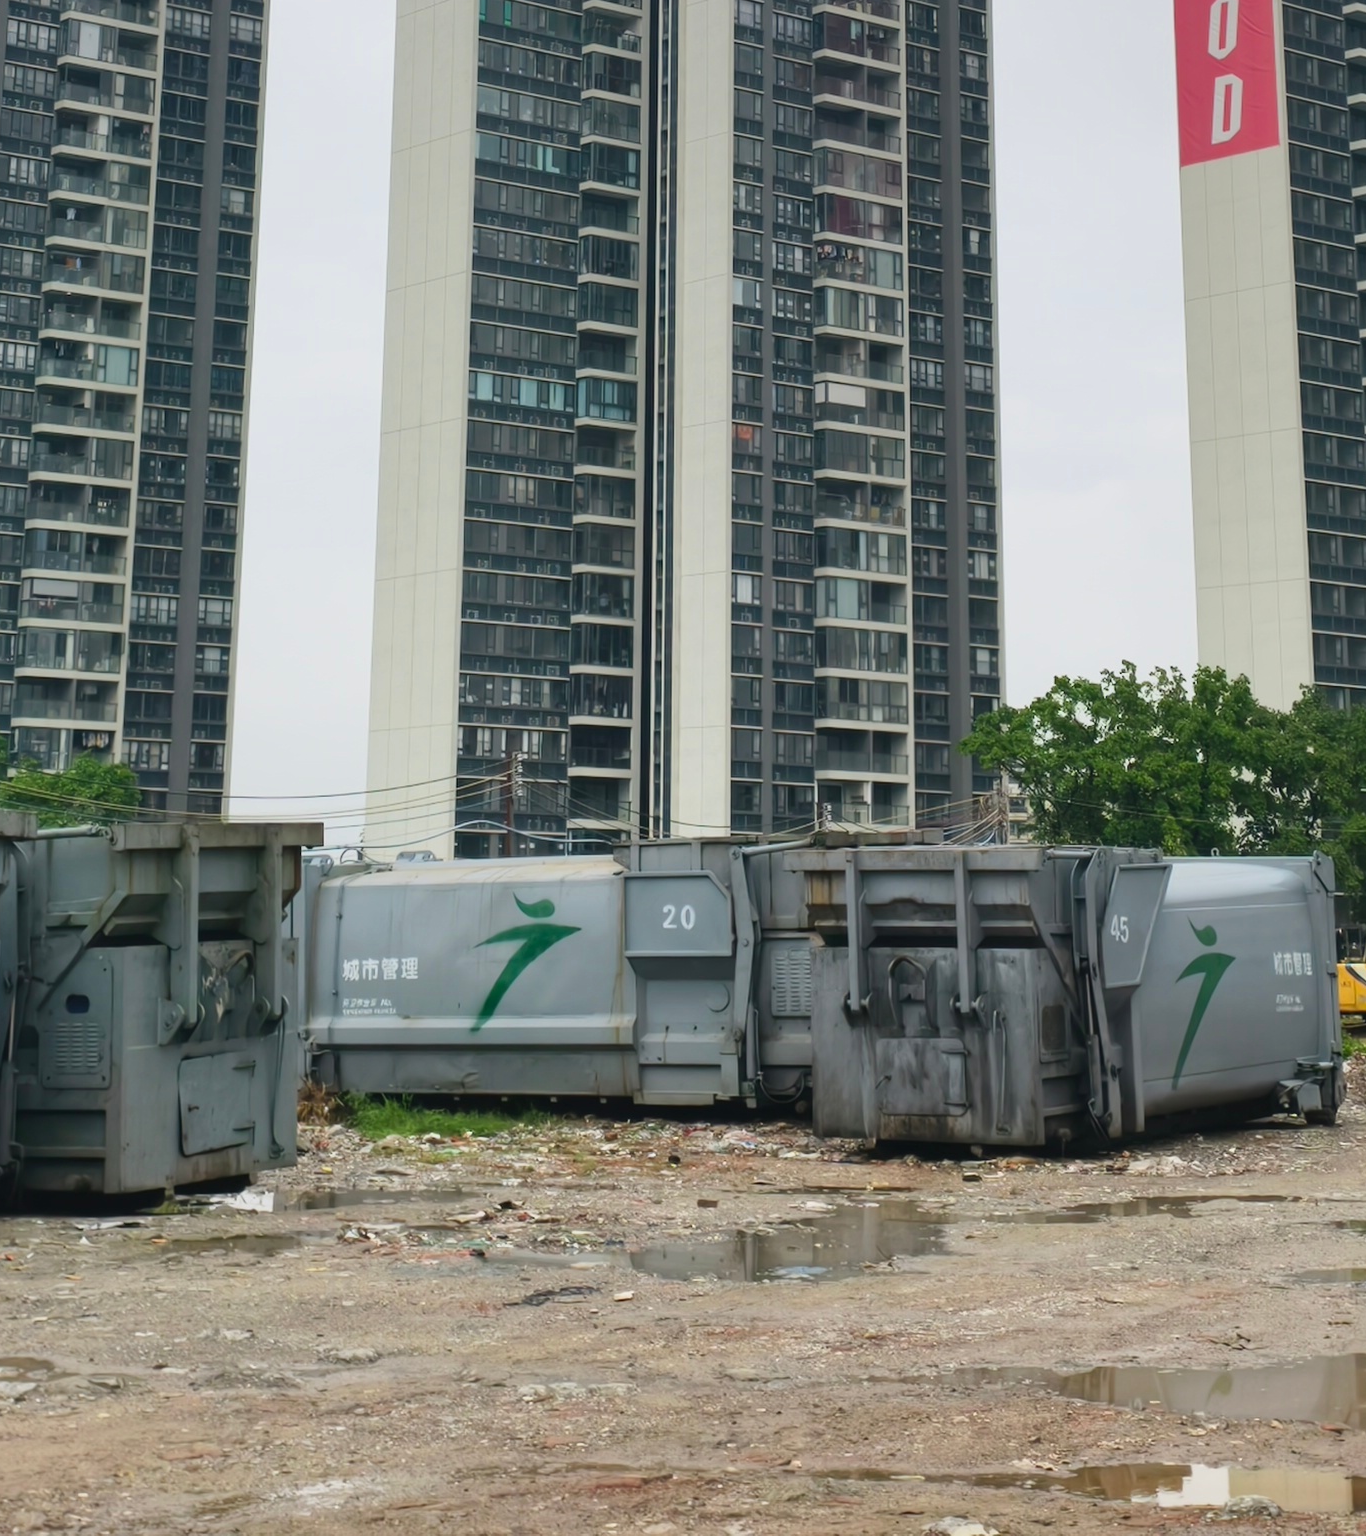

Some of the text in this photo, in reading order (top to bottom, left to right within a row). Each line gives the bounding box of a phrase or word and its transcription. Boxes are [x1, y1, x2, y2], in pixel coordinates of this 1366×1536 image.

[662, 904, 696, 930] 20
[1110, 914, 1129, 943] 45
[342, 957, 419, 981] 城市管理
